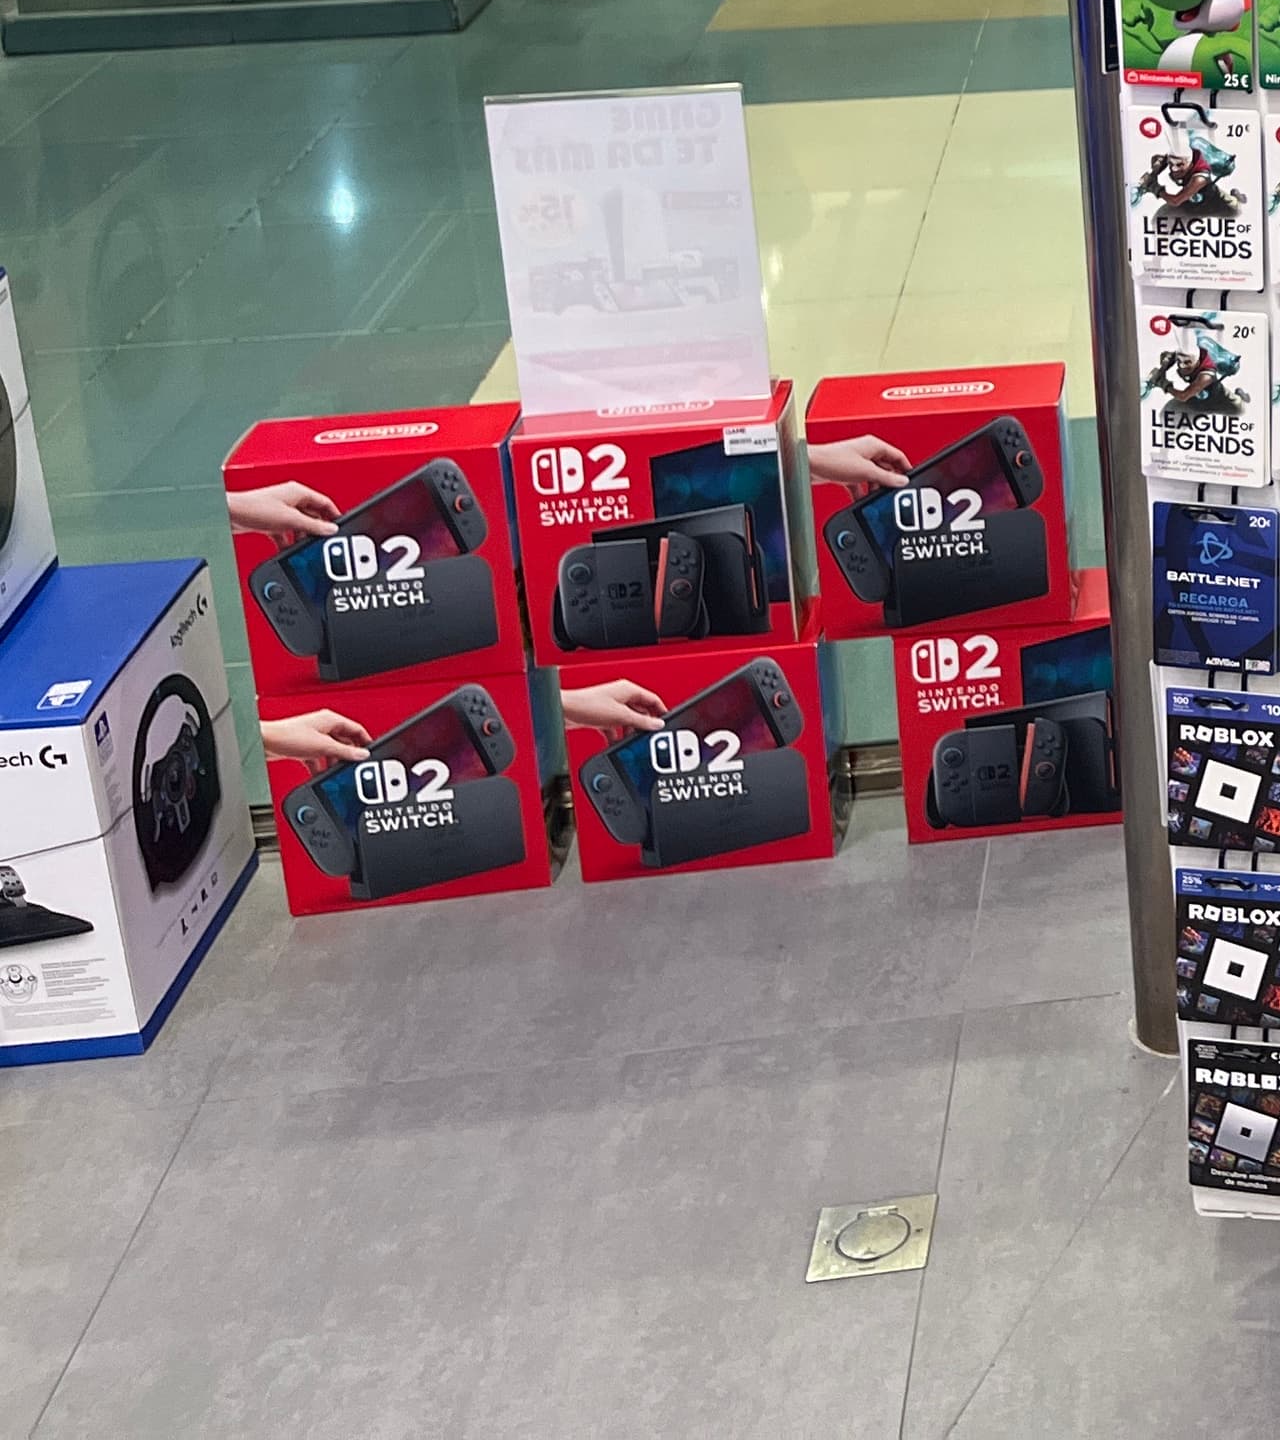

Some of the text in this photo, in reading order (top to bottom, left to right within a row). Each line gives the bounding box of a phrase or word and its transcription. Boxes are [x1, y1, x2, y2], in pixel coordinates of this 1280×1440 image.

[1143, 216, 1251, 237] LEAGUE OF
[1143, 237, 1252, 259] LEGENDS
[1152, 409, 1254, 432] LEAGUE OF
[1152, 430, 1254, 456] LEGENDS
[587, 444, 630, 491] 2
[540, 495, 627, 510] NINTENDO
[947, 489, 985, 530] 2
[540, 504, 629, 526] SWITCH
[901, 532, 982, 546] NINTENDO
[380, 536, 425, 580] 2
[902, 541, 985, 560] SWITCH
[333, 581, 424, 596] NINTENDO
[334, 591, 425, 612] SWITCH
[1179, 592, 1248, 608] RECARGA
[1180, 725, 1274, 747] ROBLOX
[703, 731, 744, 772] 2
[411, 759, 454, 801] 2
[658, 773, 742, 788] NINTENDO
[659, 783, 744, 802] SWITCH
[365, 803, 452, 817] NINTENDO
[366, 812, 455, 834] SWITCH
[1211, 1168, 1280, 1184] Descubre millones
[1225, 1178, 1267, 1190] de mundos
